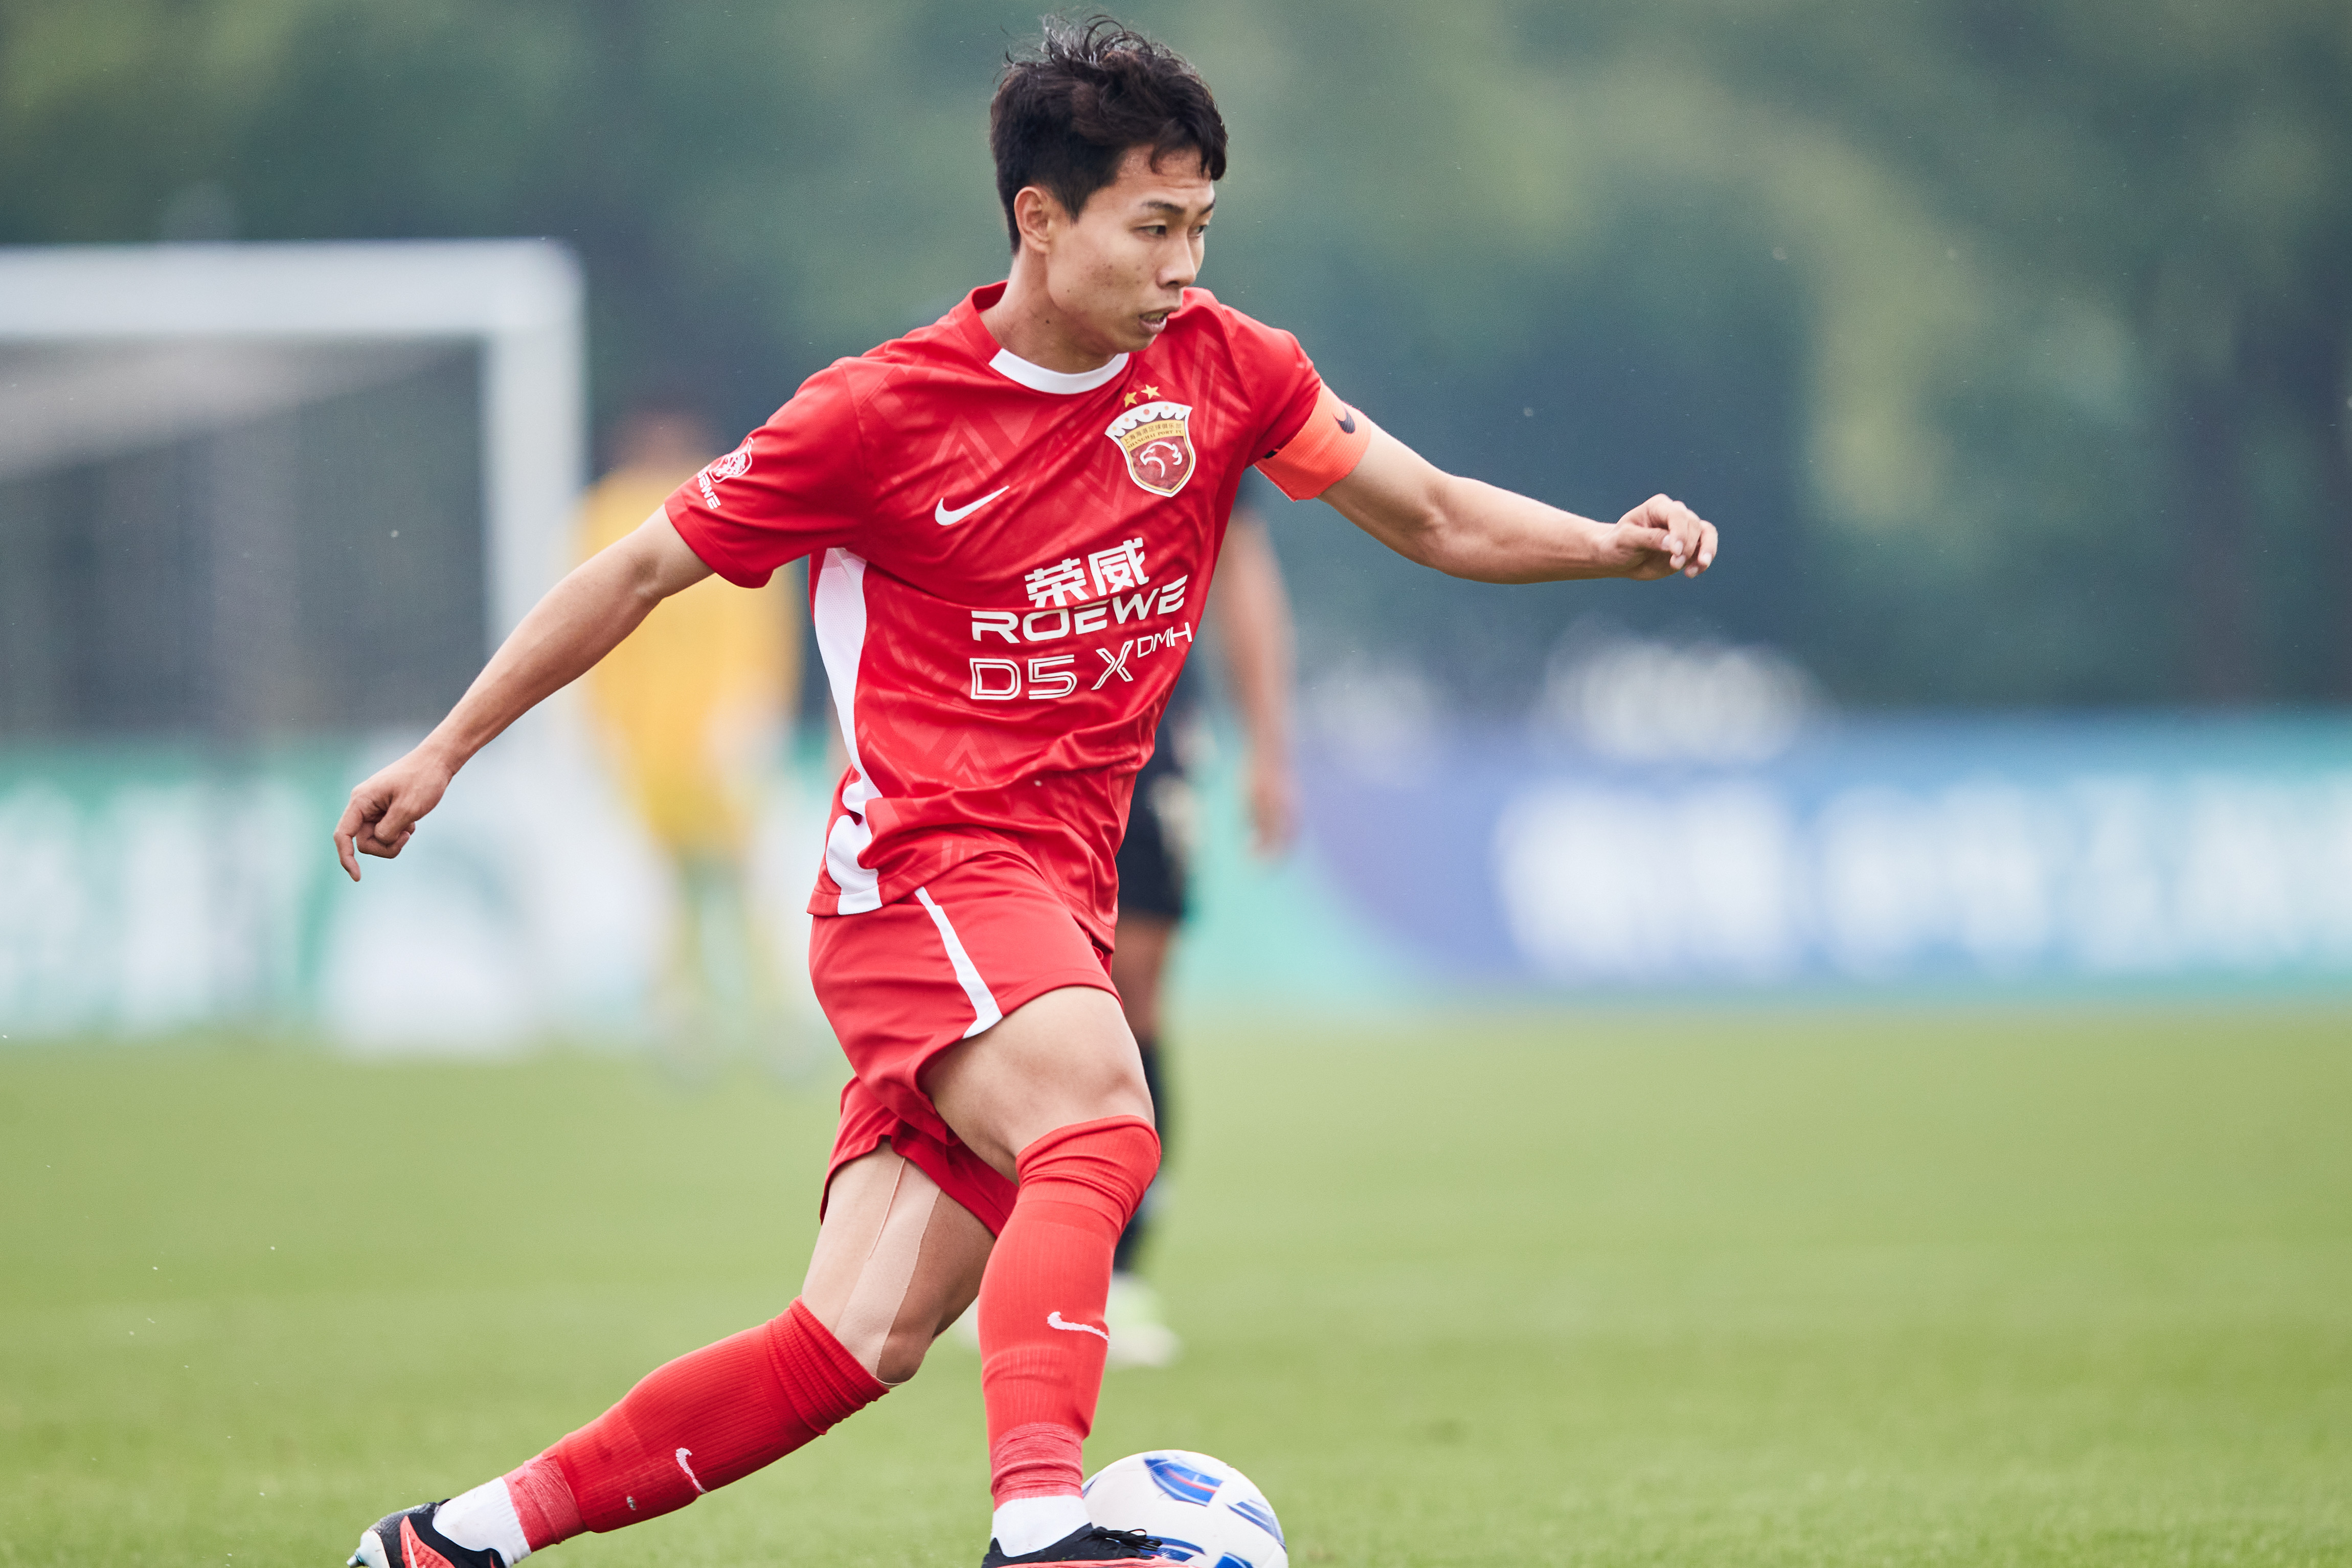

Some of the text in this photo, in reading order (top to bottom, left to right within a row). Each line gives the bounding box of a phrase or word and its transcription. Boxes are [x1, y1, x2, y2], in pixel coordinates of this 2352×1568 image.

[1025, 537, 1149, 608] 荣威
[971, 575, 1187, 644] ROEWE
[1138, 622, 1192, 658] DMH
